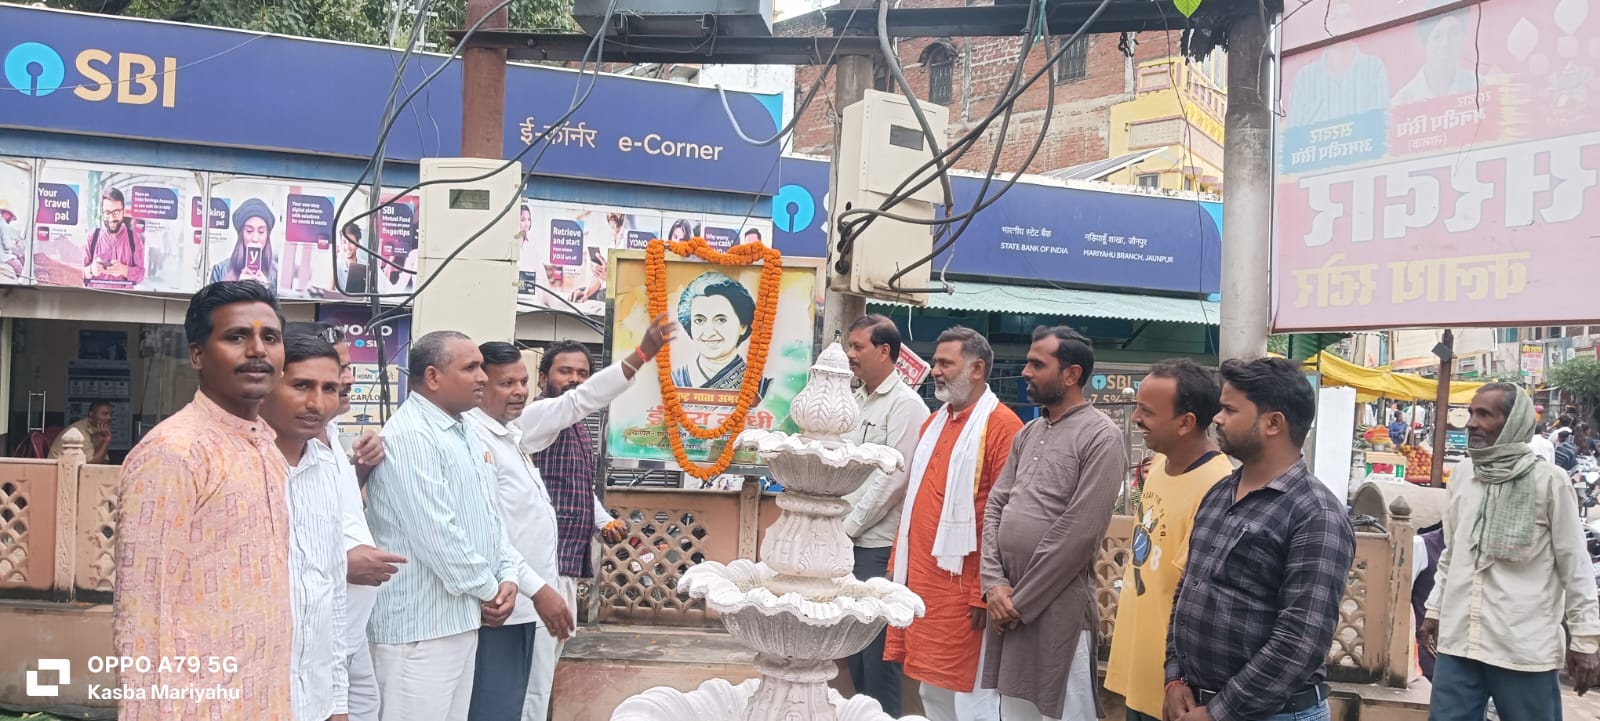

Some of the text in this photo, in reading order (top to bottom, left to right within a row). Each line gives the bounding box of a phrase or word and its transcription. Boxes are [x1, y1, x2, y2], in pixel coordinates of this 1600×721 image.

[74, 49, 177, 109] SBI
[618, 133, 723, 161] e-Corner
[38, 187, 58, 197] Your
[44, 198, 70, 208] travel
[382, 205, 395, 215] SBI
[54, 210, 70, 222] pal
[382, 228, 411, 238] fingertips
[553, 227, 582, 237] Retrieve
[553, 237, 581, 247] and start
[1000, 242, 1069, 255] STATE BANK OF INDIA
[552, 253, 565, 261] you
[1083, 249, 1116, 259] MARIYAHU
[1145, 254, 1174, 264] JAUNPUR
[1107, 375, 1131, 390] SBI
[1091, 393, 1123, 404] 75%
